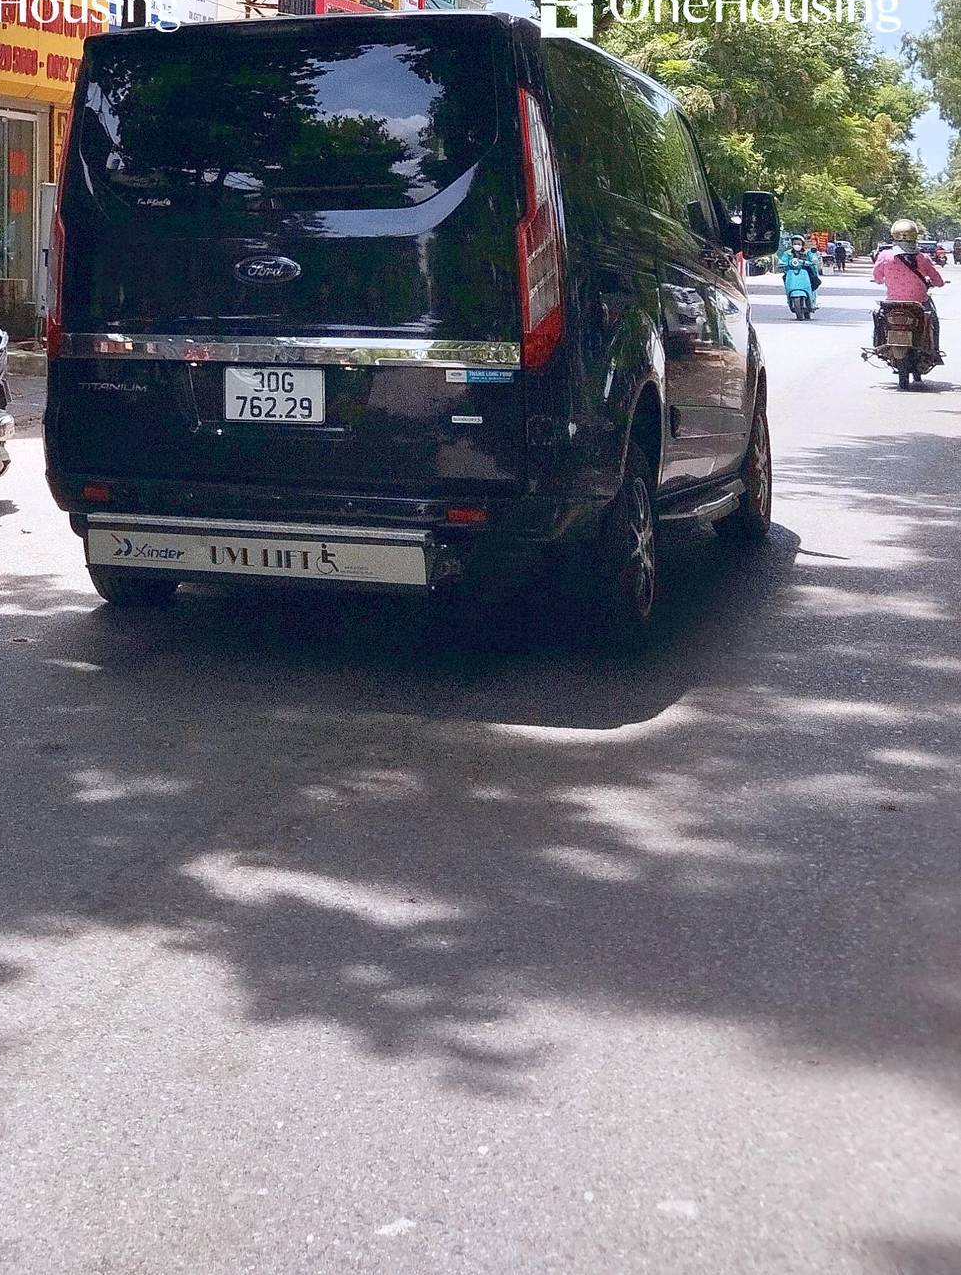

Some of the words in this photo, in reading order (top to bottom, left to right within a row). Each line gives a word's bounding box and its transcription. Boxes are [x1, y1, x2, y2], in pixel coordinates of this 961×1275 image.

[247, 260, 285, 277] Ford
[78, 382, 147, 392] TITANIUM
[252, 371, 294, 393] 30G
[236, 395, 313, 419] 762.29
[262, 548, 311, 571] LIFT
